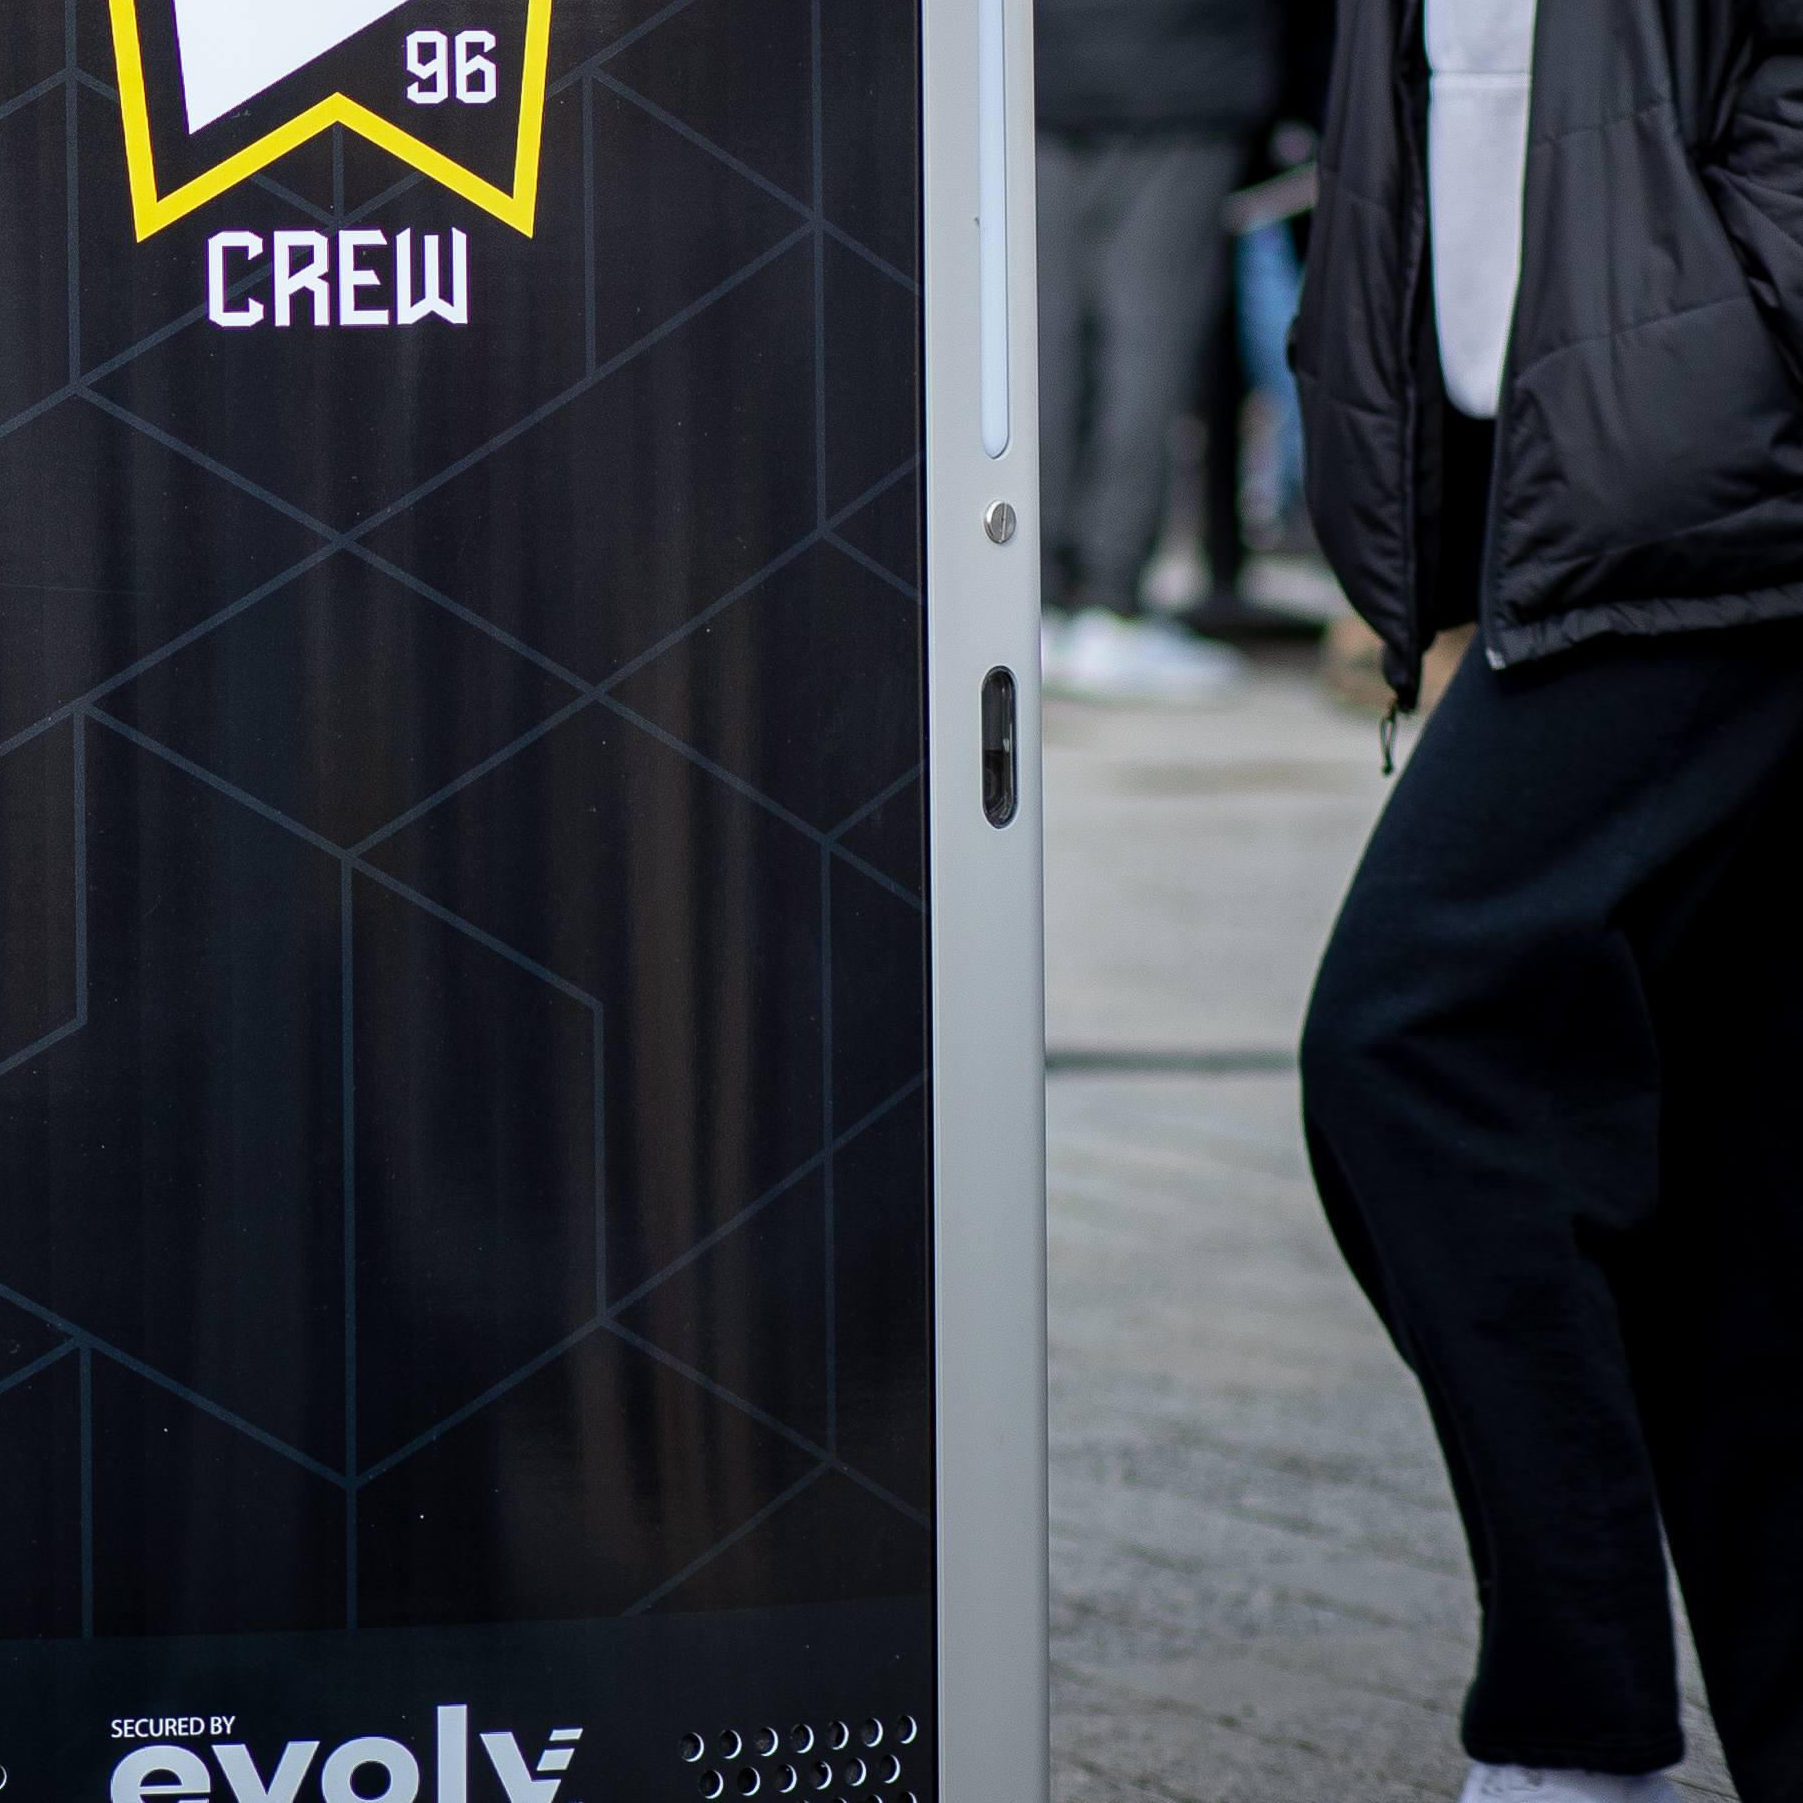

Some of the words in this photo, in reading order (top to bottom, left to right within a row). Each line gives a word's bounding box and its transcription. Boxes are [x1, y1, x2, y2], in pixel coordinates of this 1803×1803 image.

[406, 30, 497, 104] 96
[207, 226, 468, 328] CREW
[110, 1717, 205, 1738] SECURED
[210, 1715, 236, 1735] BY
